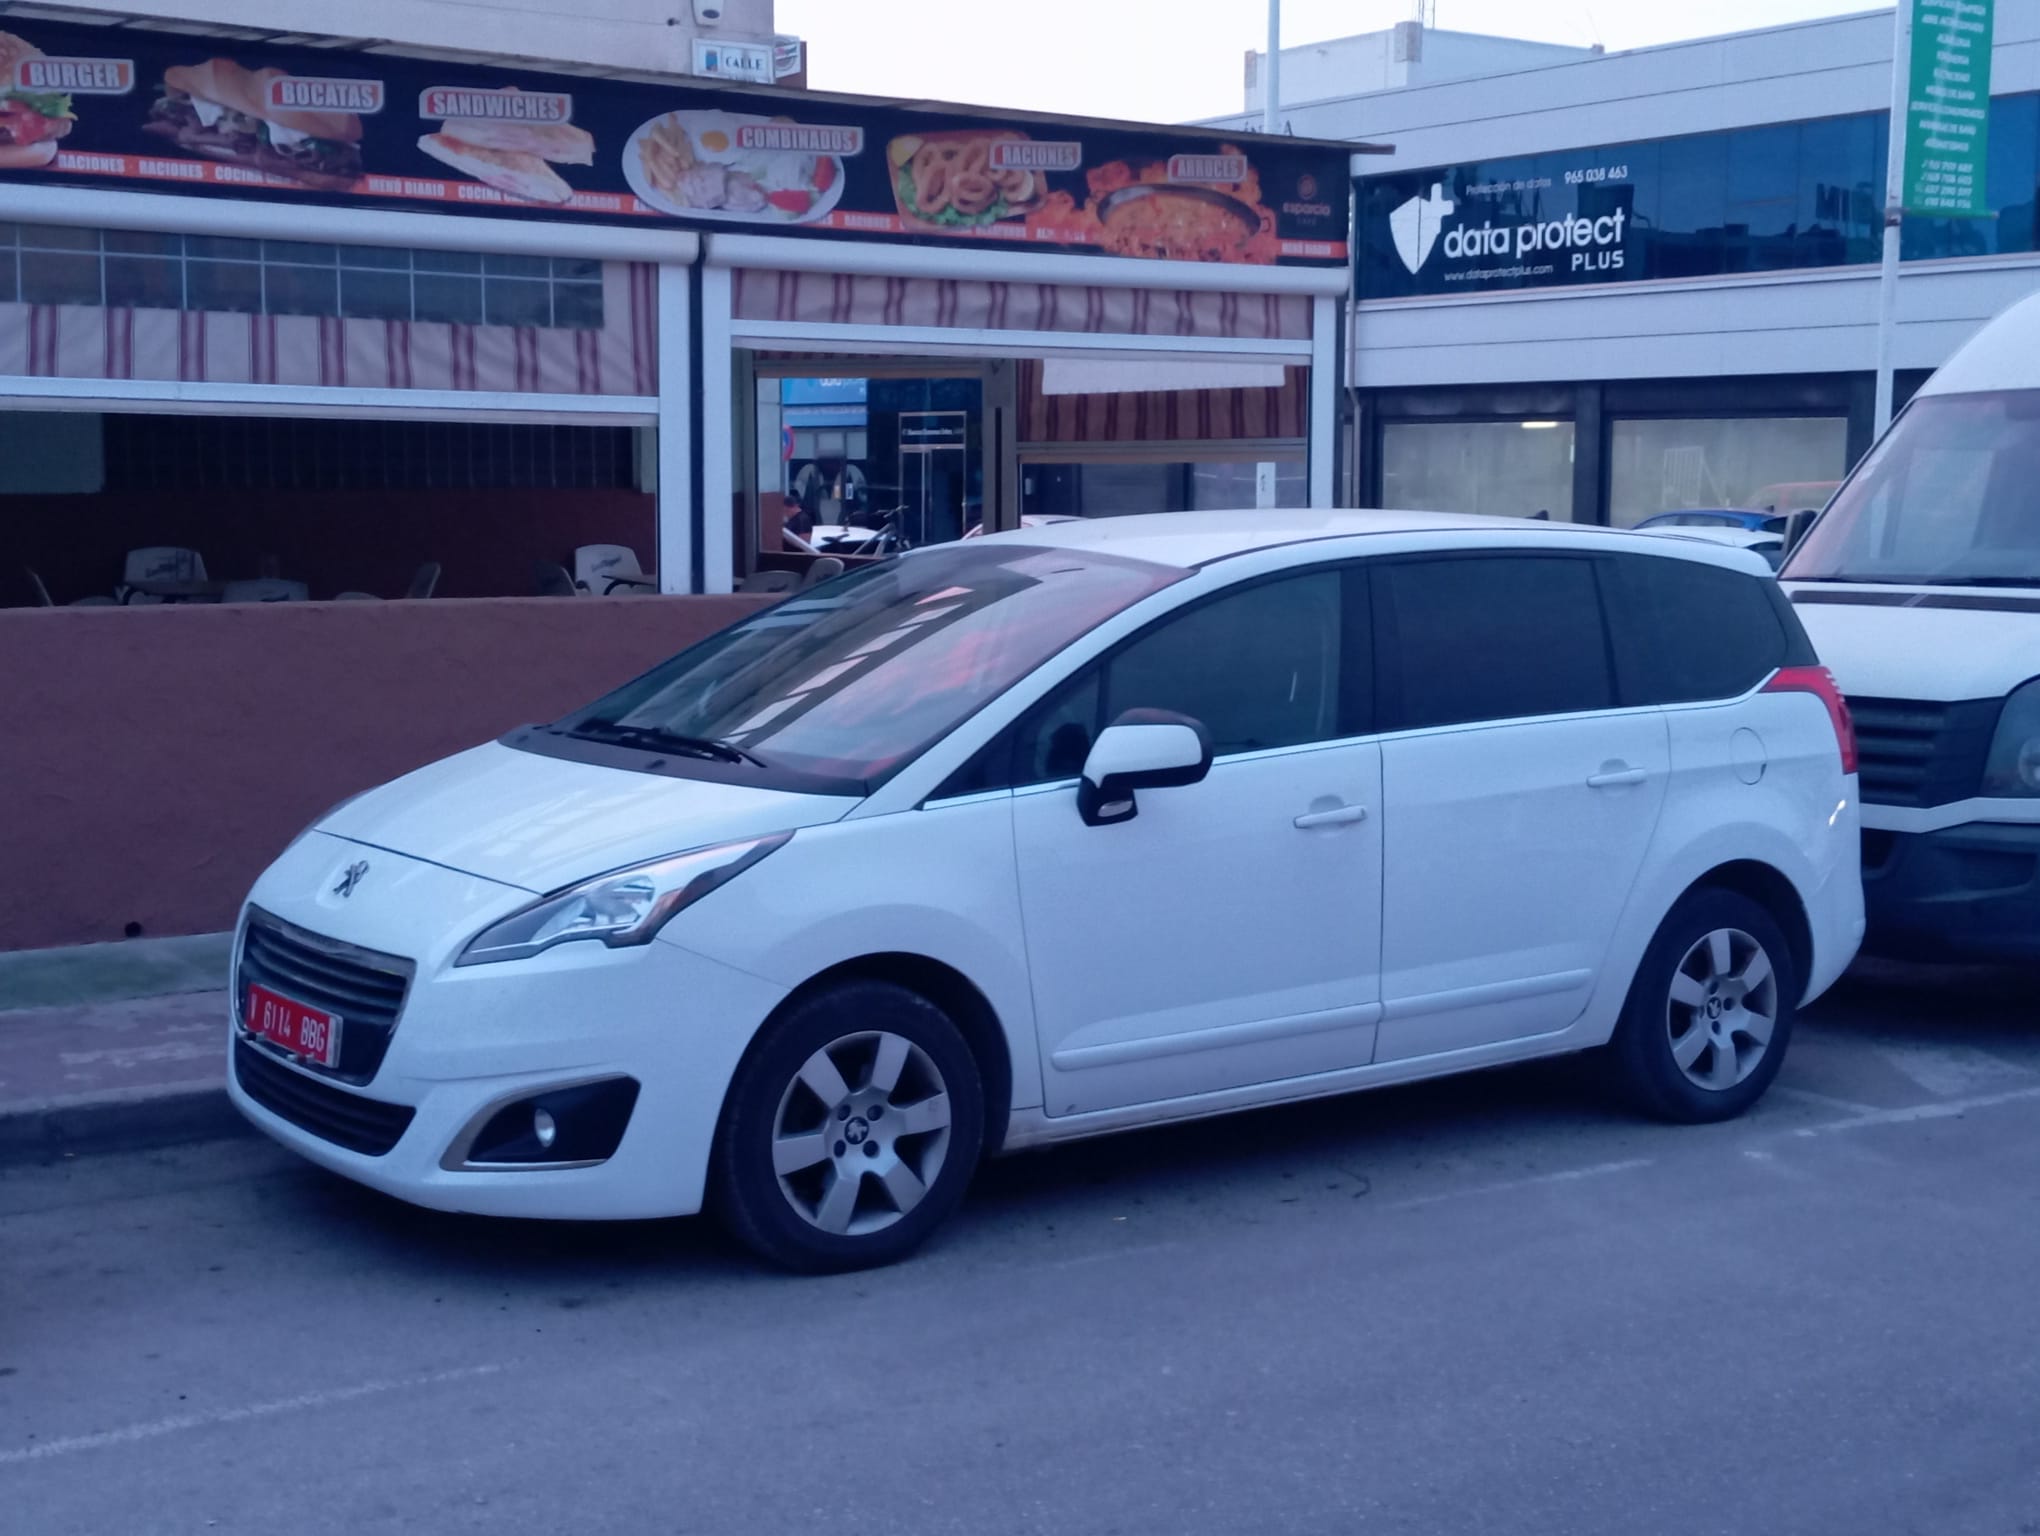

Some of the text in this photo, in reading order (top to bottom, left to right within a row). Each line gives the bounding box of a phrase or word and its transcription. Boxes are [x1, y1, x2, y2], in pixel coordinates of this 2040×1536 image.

[30, 63, 121, 88] BURGER
[726, 56, 762, 71] CALLE
[282, 82, 374, 108] BOCATAS
[433, 91, 560, 119] SANDWICHES
[742, 127, 853, 151] COMBINADOS
[58, 154, 125, 173] RACIONES
[139, 159, 203, 178] RACIONES
[1003, 144, 1073, 166] RACIONES
[1564, 165, 1628, 185] 965 038 463
[1444, 207, 1625, 259] data protect
[1571, 250, 1624, 272] PLUS
[263, 1001, 291, 1038] 6114
[300, 1016, 326, 1052] BBG
